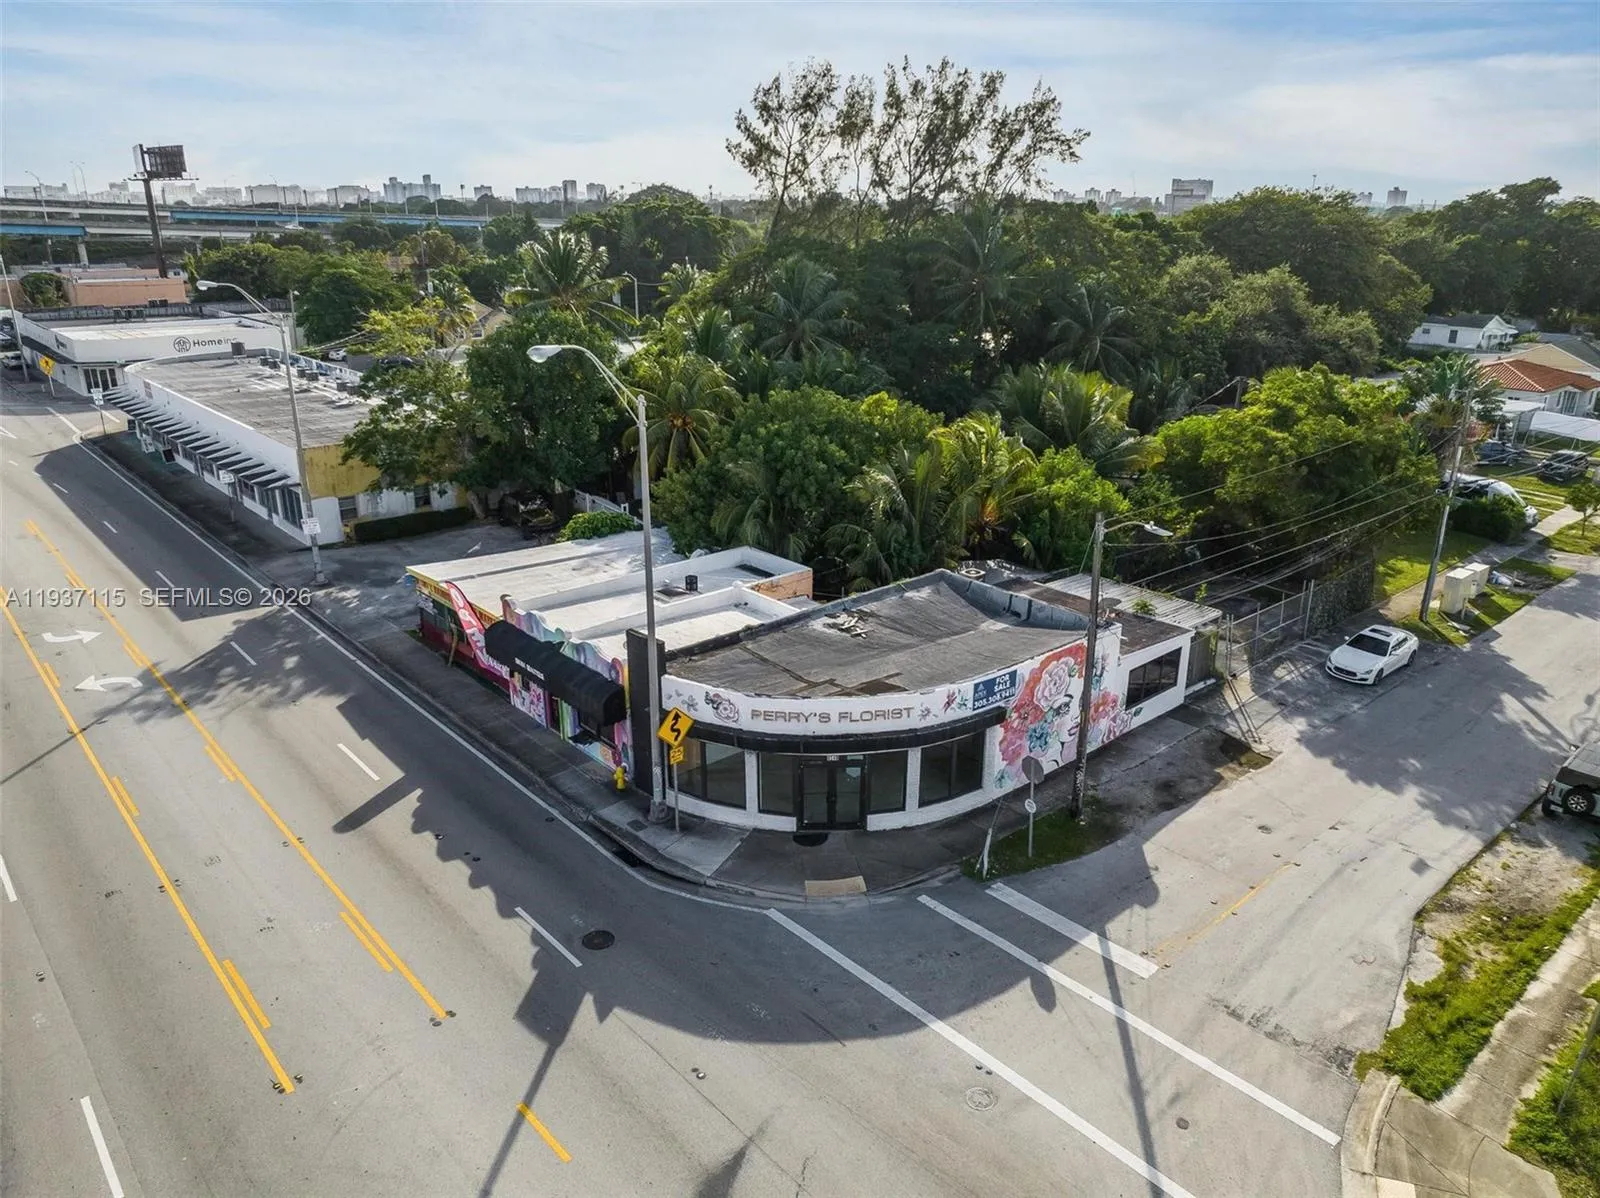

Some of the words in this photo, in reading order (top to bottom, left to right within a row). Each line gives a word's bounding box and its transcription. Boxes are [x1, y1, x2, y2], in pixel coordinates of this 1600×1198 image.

[996, 673, 1009, 685] FOR
[994, 680, 1010, 692] SALE
[751, 709, 832, 724] PERRY'S
[837, 707, 916, 723] FLORIST
